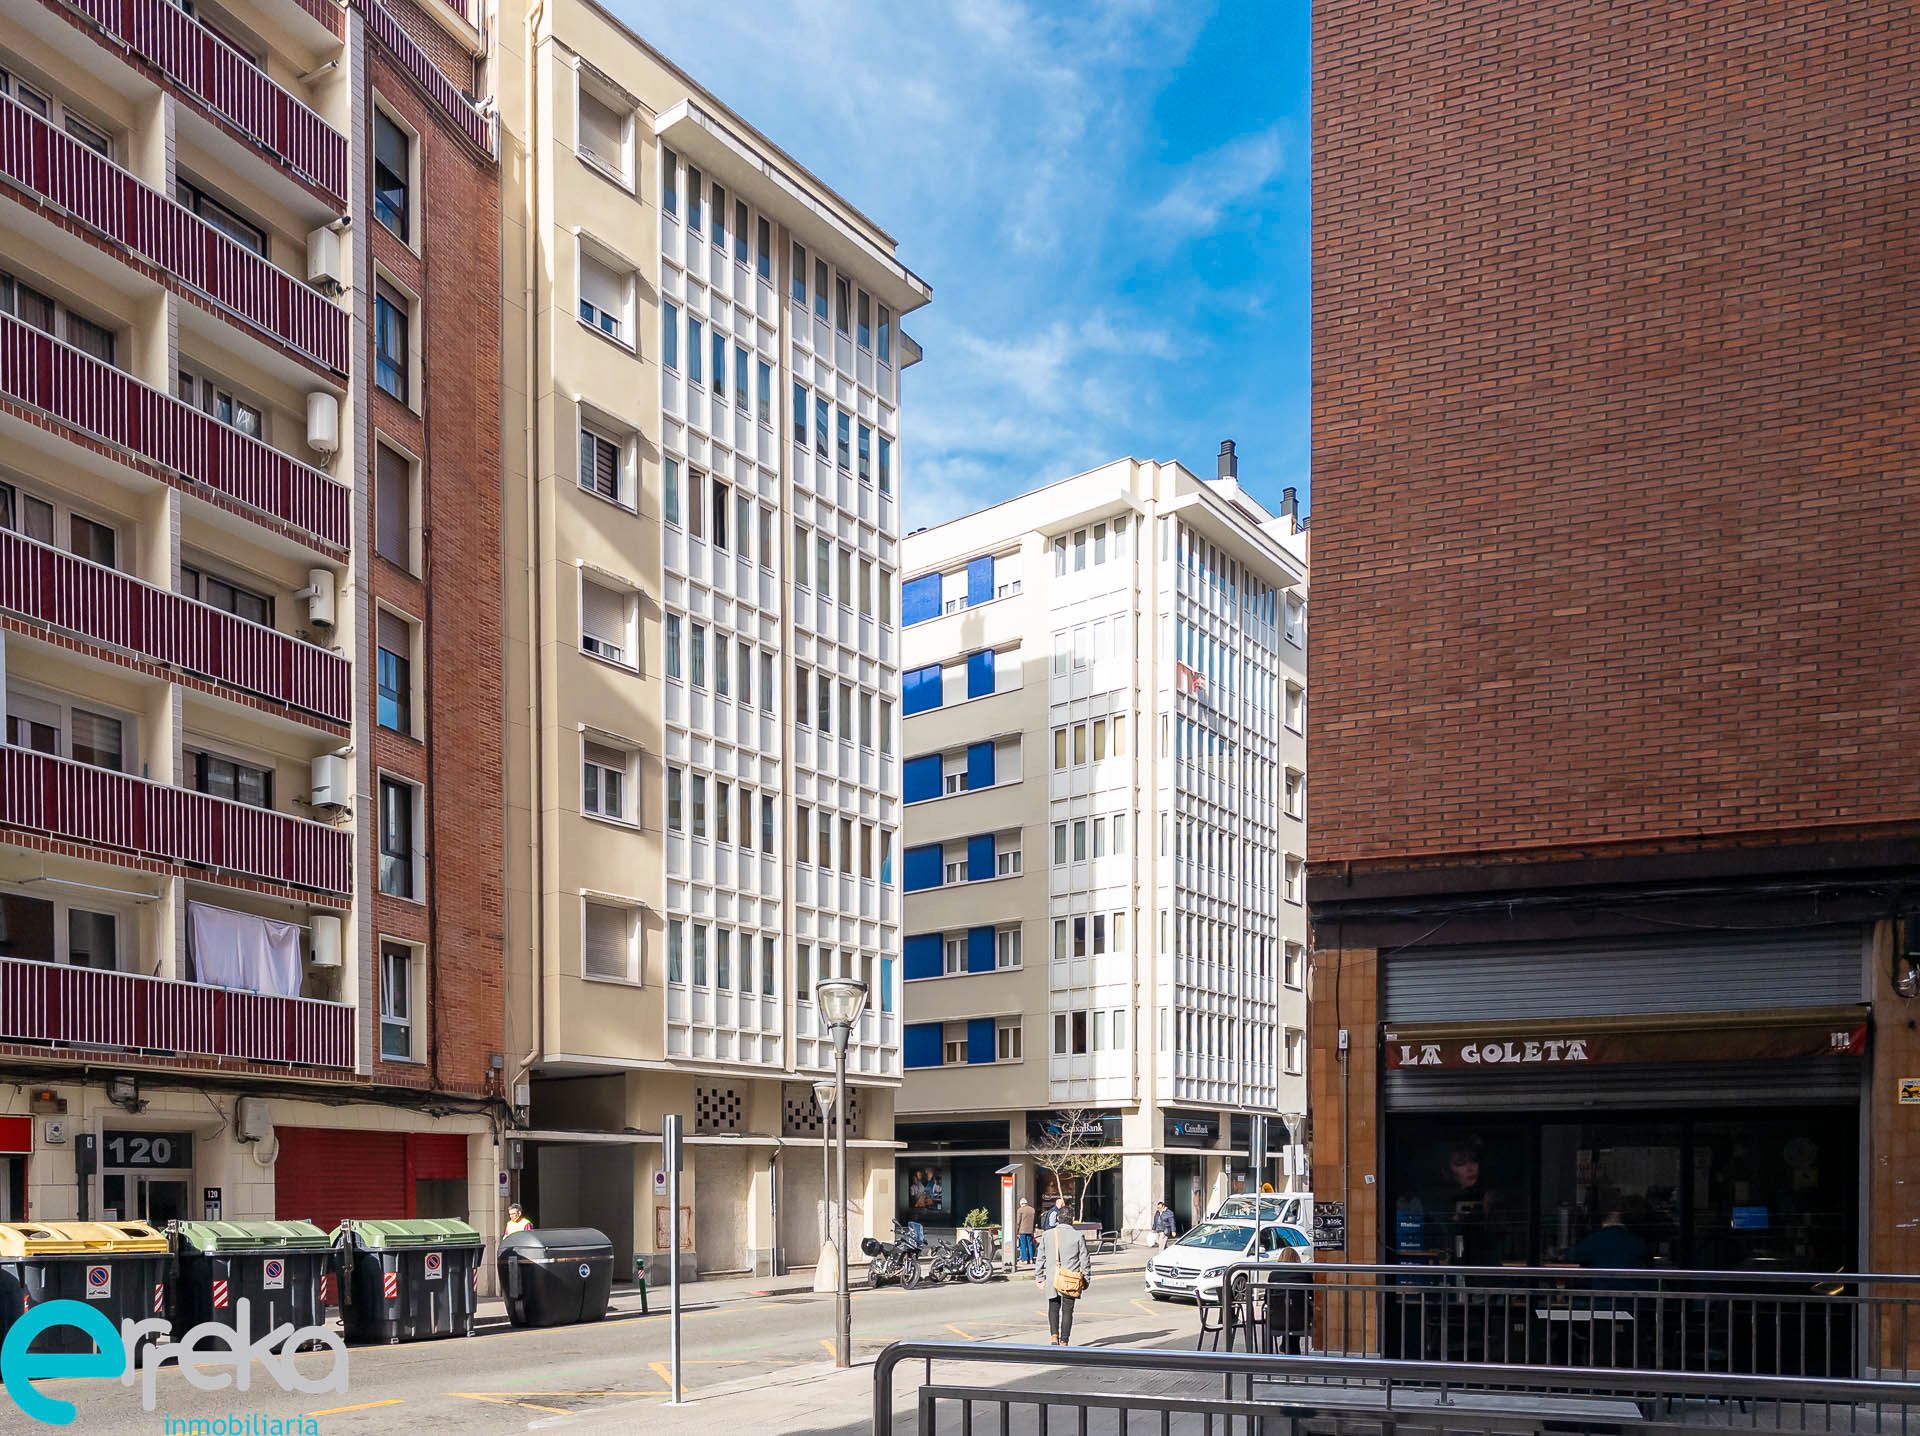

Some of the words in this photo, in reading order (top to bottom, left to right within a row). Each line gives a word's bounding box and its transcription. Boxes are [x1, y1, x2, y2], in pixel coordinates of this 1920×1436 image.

[1399, 1045, 1442, 1065] LA
[1460, 1039, 1589, 1064] GOLETA
[109, 1137, 172, 1163] 120
[207, 1190, 218, 1199] 120
